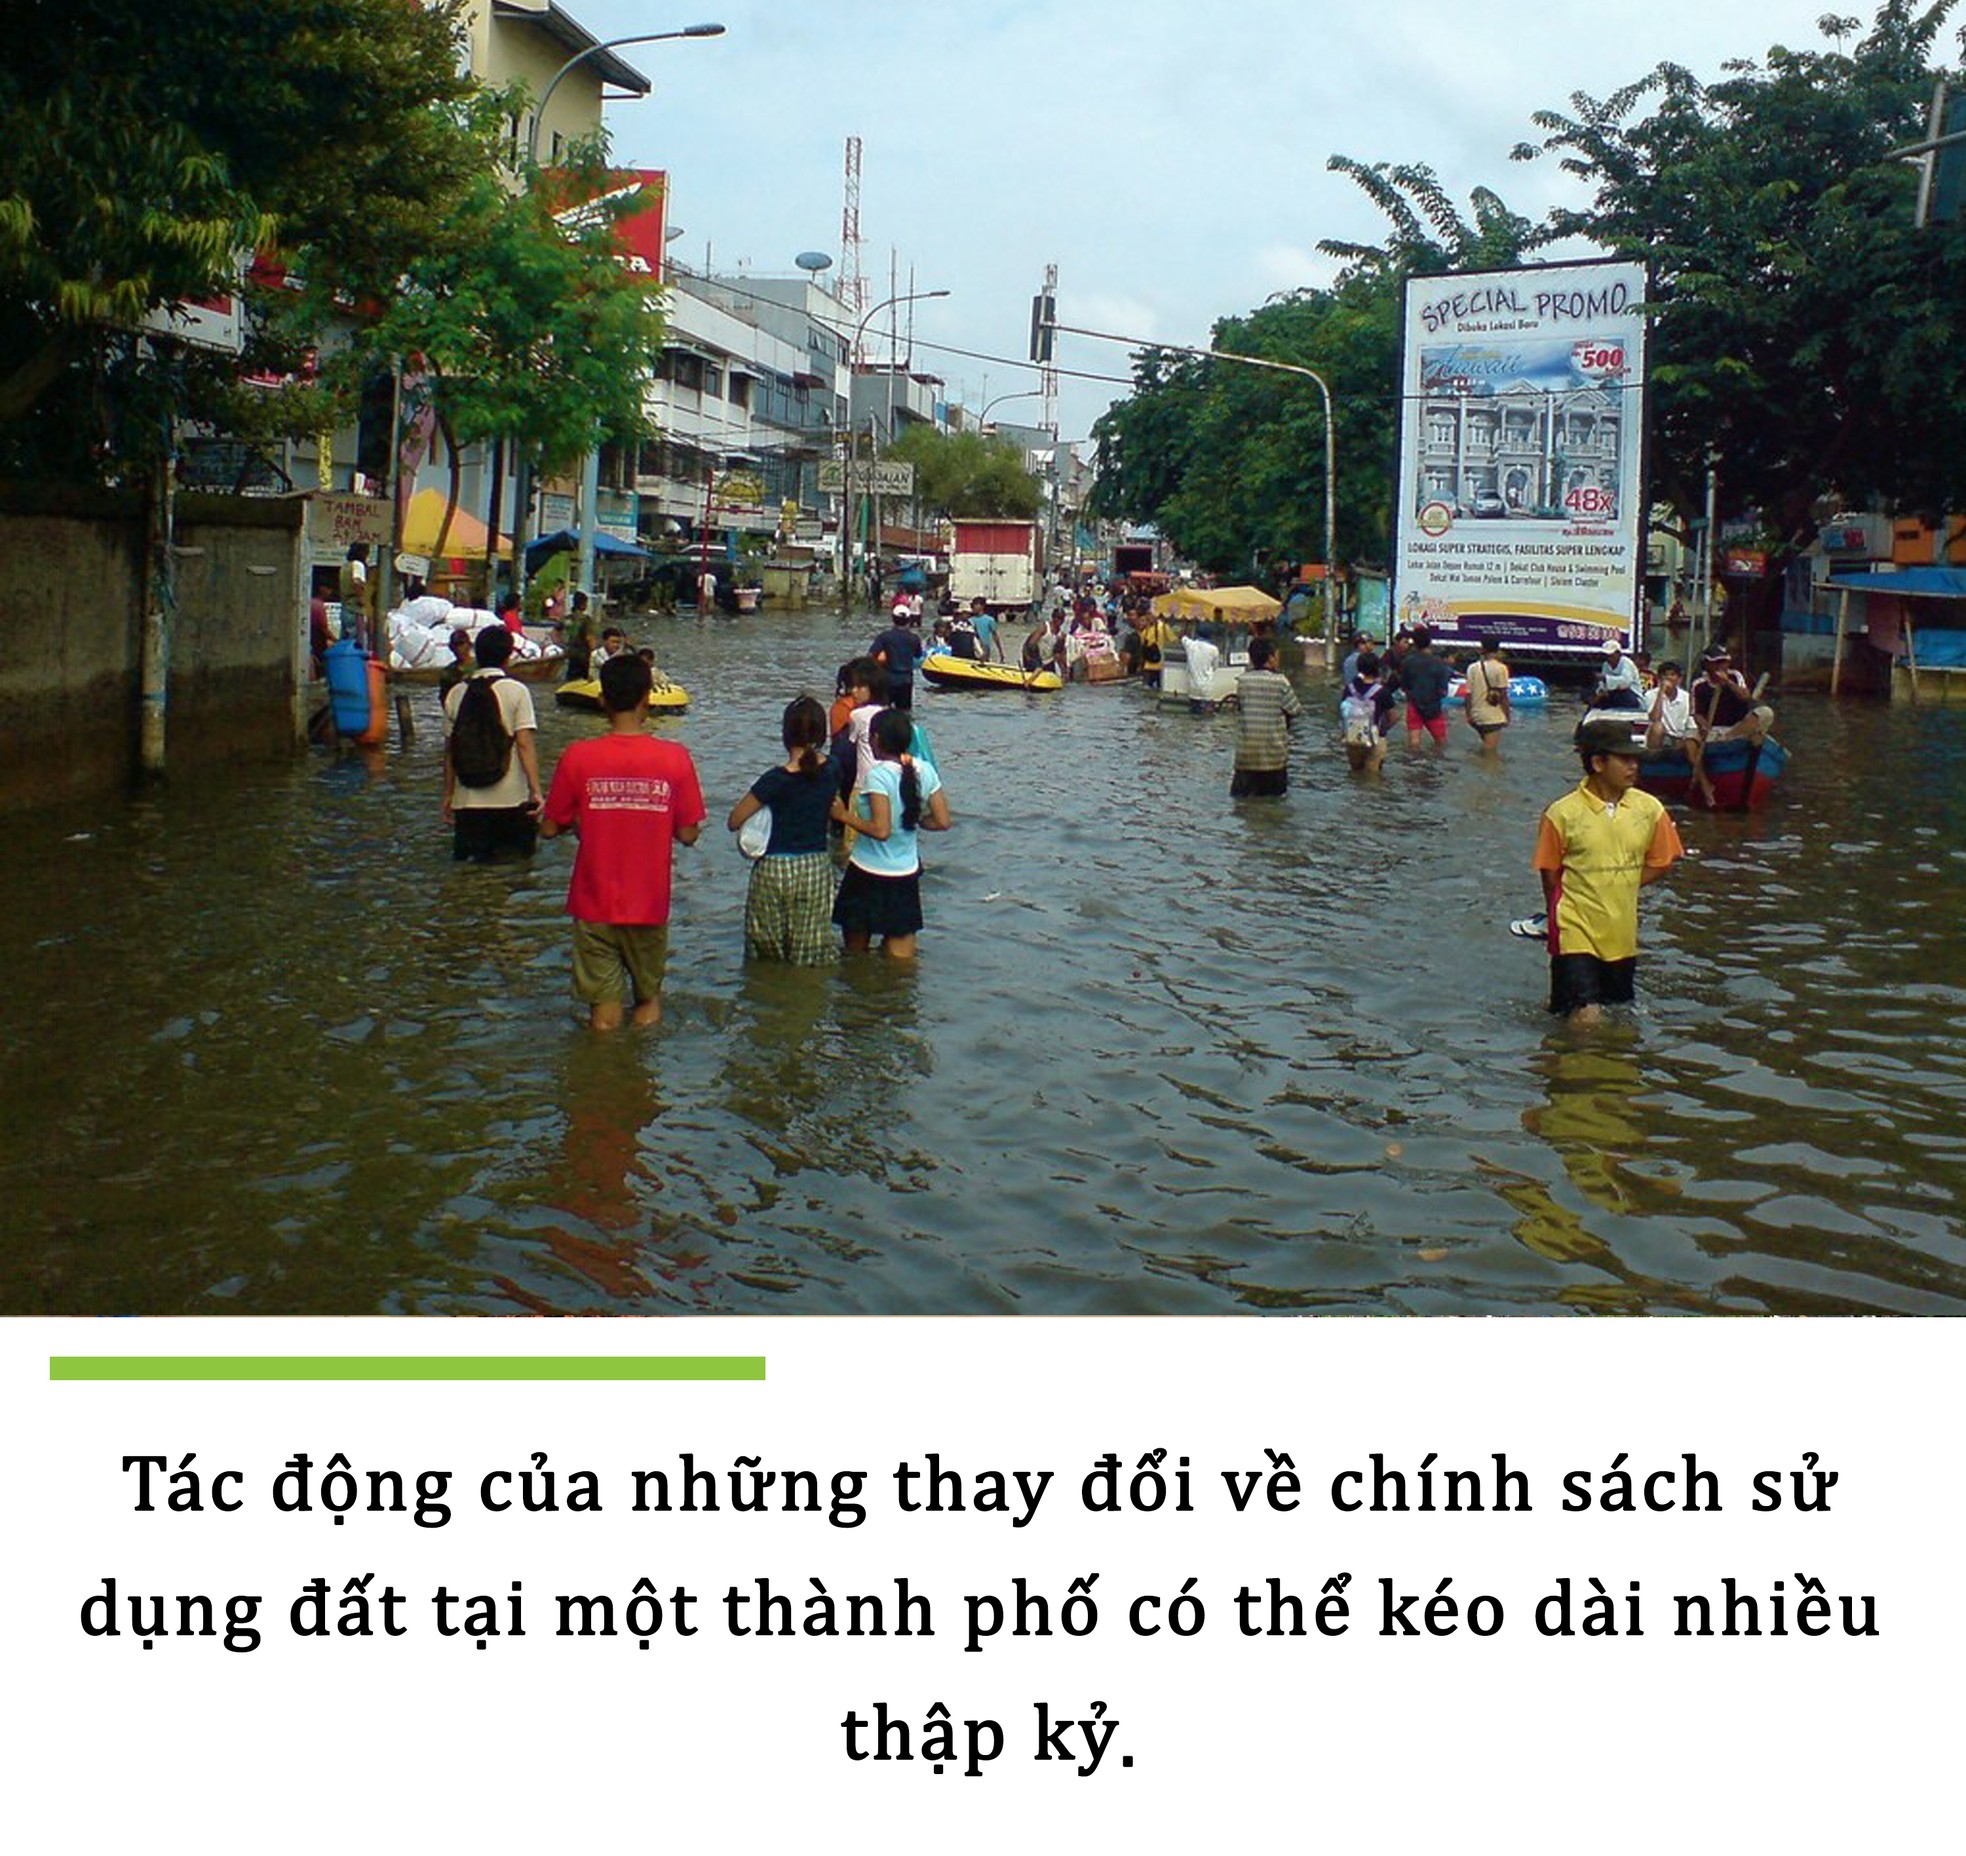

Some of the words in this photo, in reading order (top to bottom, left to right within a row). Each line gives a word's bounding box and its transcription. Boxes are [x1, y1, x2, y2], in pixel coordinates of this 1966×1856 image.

[1421, 288, 1527, 333] SPECIAL
[1535, 282, 1627, 320] PROMO
[1518, 319, 1539, 330] Baru
[1582, 348, 1624, 369] 500
[323, 499, 382, 518] TAMBAL
[1407, 542, 1436, 554] LOKASI
[1438, 543, 1465, 554] SUPER
[1514, 544, 1554, 556] FASILITAS
[1556, 545, 1583, 556] SUPER
[1585, 545, 1626, 556] LENGKAP
